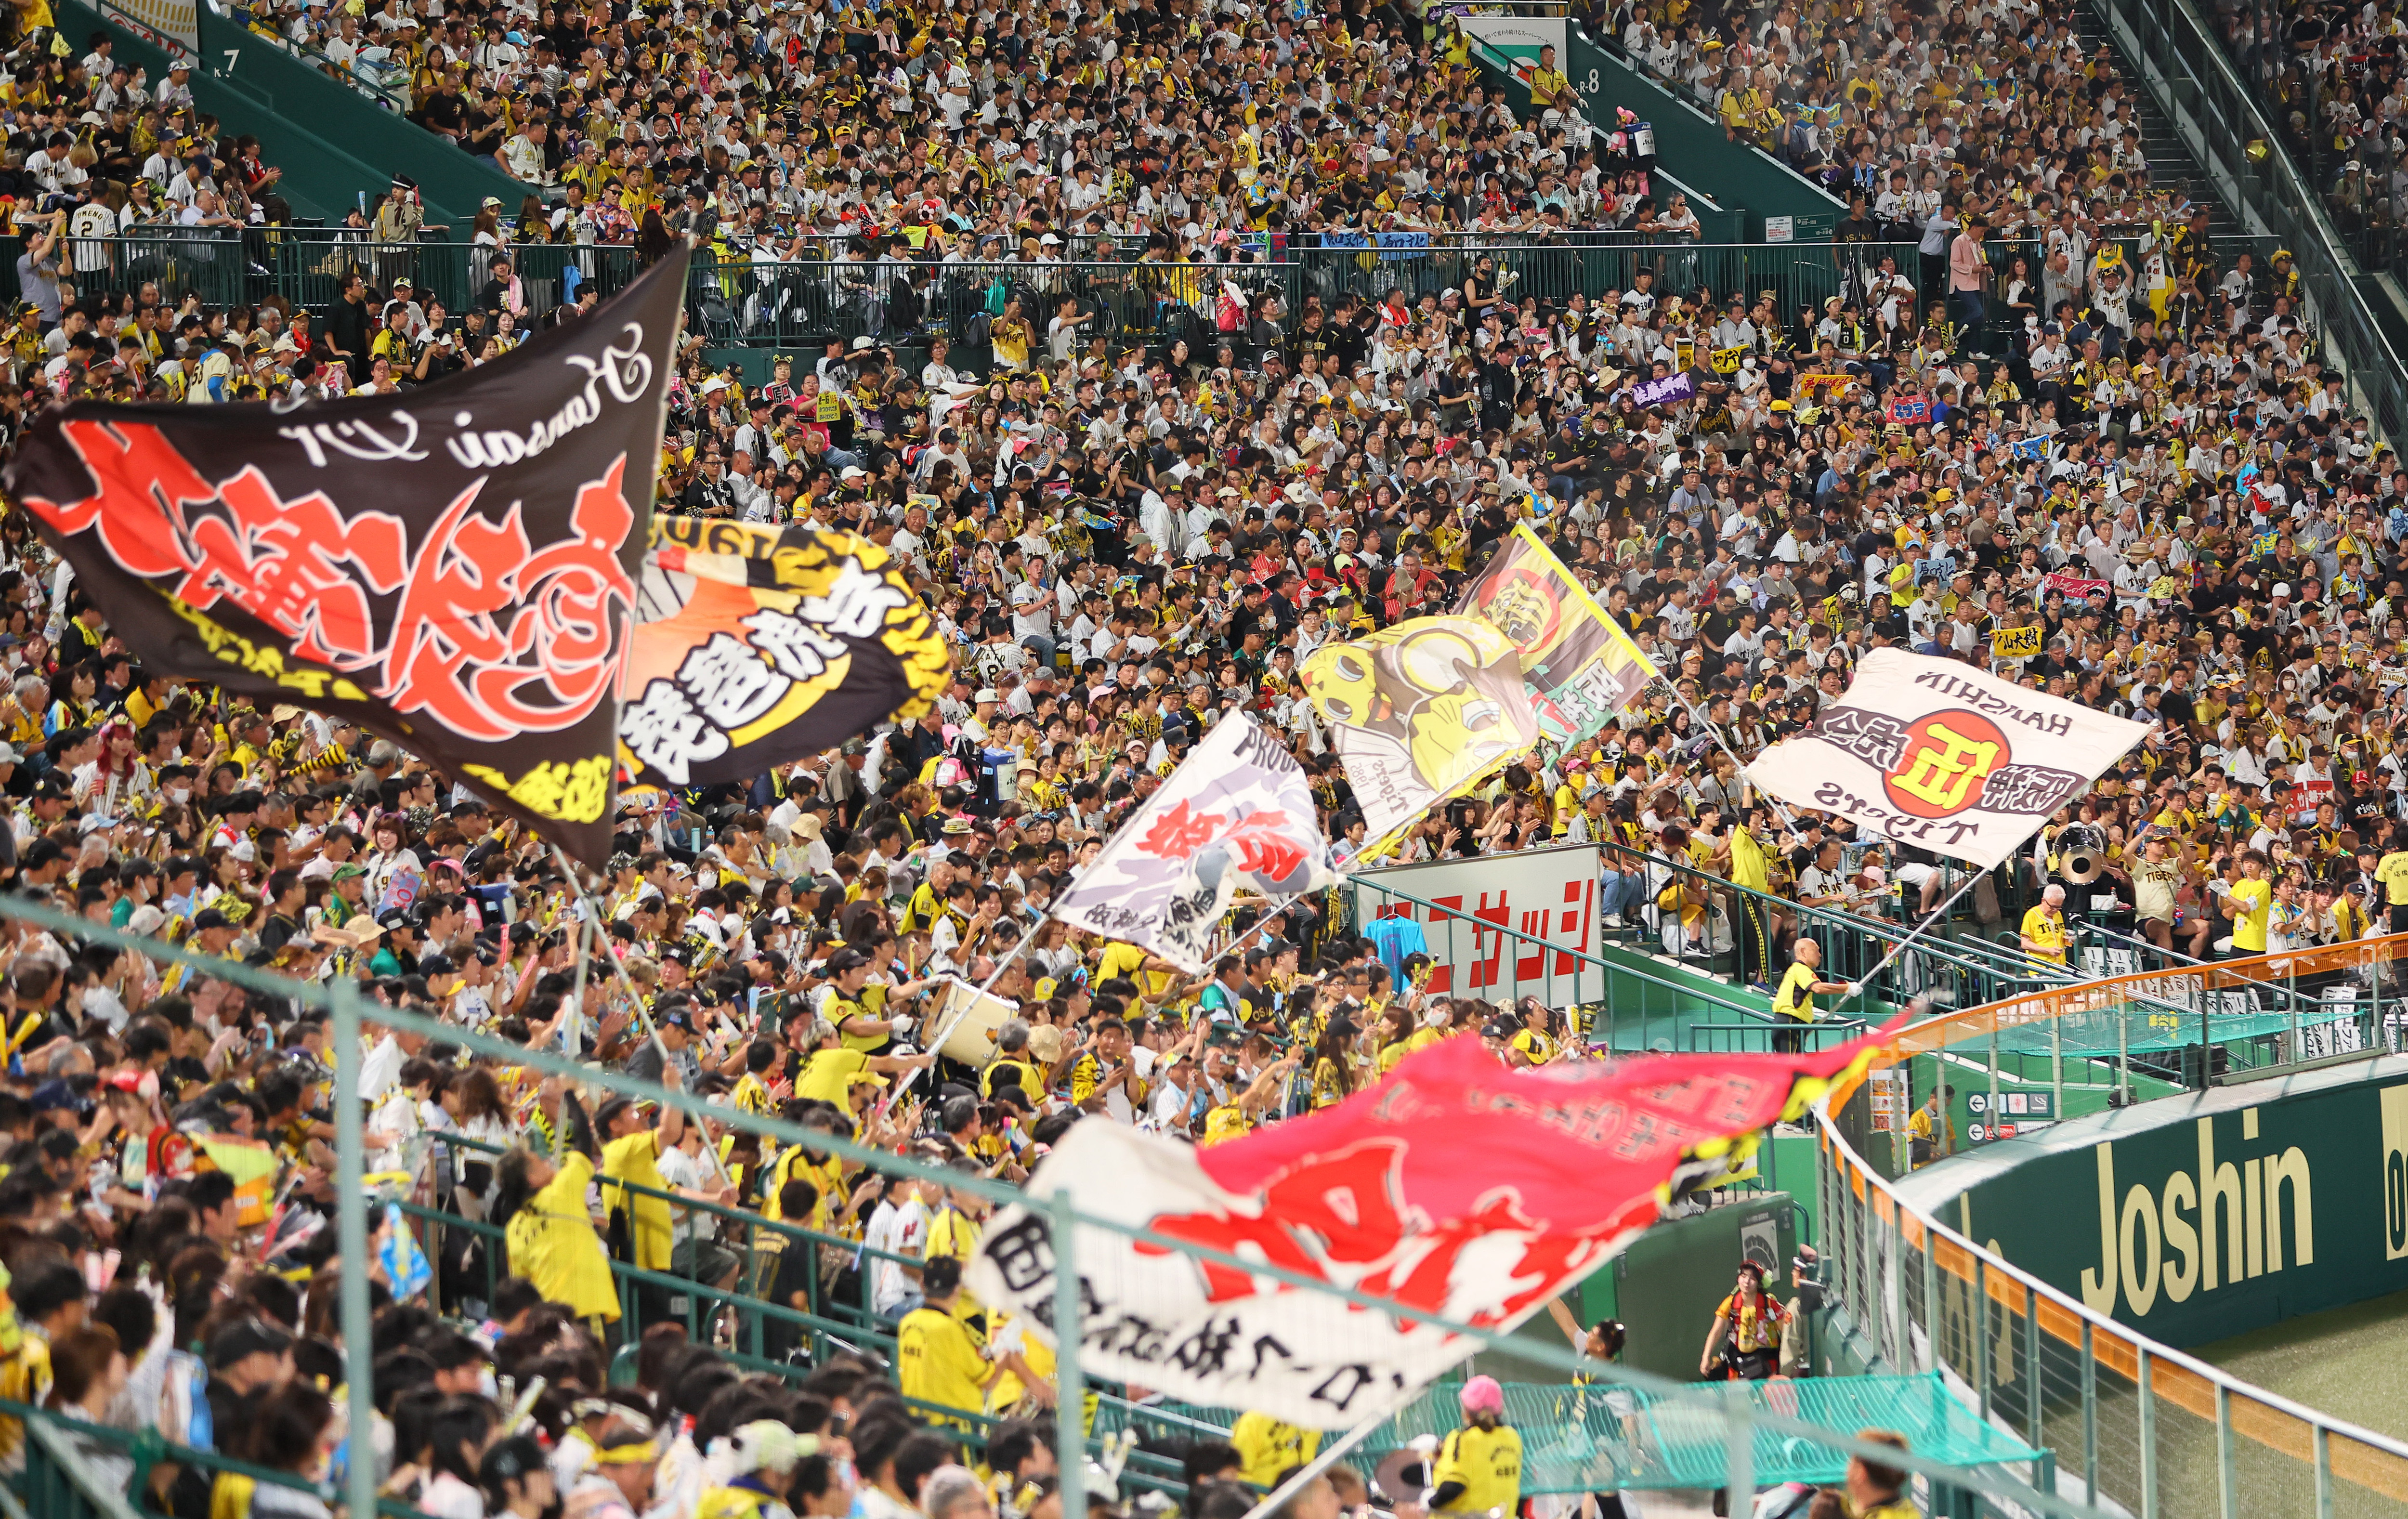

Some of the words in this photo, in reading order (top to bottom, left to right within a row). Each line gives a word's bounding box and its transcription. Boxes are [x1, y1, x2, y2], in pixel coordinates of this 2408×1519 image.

[1580, 68, 1599, 93] R-8
[81, 221, 92, 236] 2
[1634, 373, 1691, 406] 佐藤輝明
[1377, 879, 1595, 995] ニサッシ
[2080, 1107, 2313, 1318] Joshin
